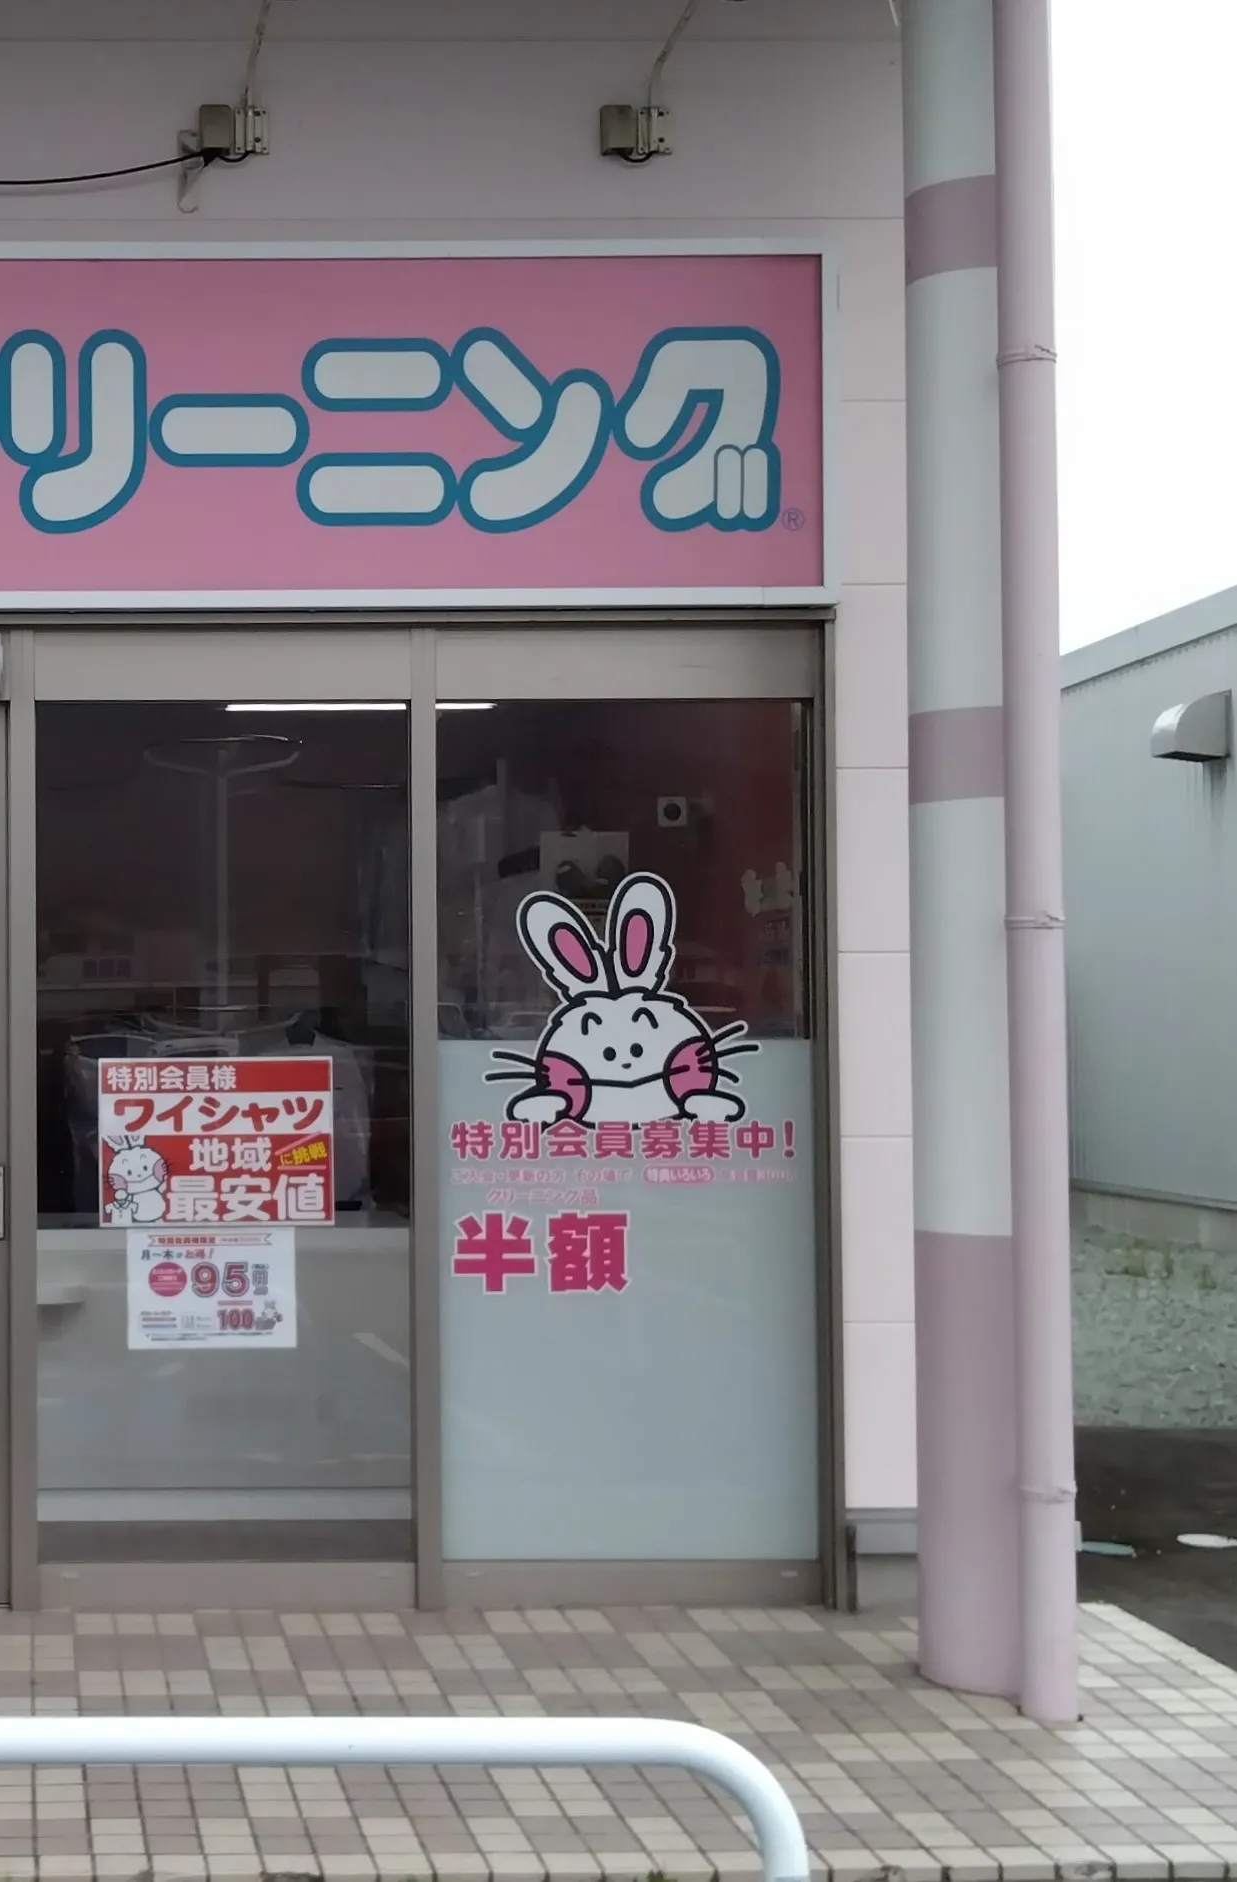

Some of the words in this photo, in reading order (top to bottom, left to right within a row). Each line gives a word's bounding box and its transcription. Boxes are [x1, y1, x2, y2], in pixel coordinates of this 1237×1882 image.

[107, 1066, 237, 1091] 特別会員様
[114, 1095, 324, 1132] ワイシャツ
[189, 1137, 272, 1172] 地域
[279, 1141, 327, 1165] に挑戦
[451, 1119, 796, 1160] 特別会員募集中！
[166, 1173, 326, 1221] 最安値
[451, 1210, 632, 1294] 半額
